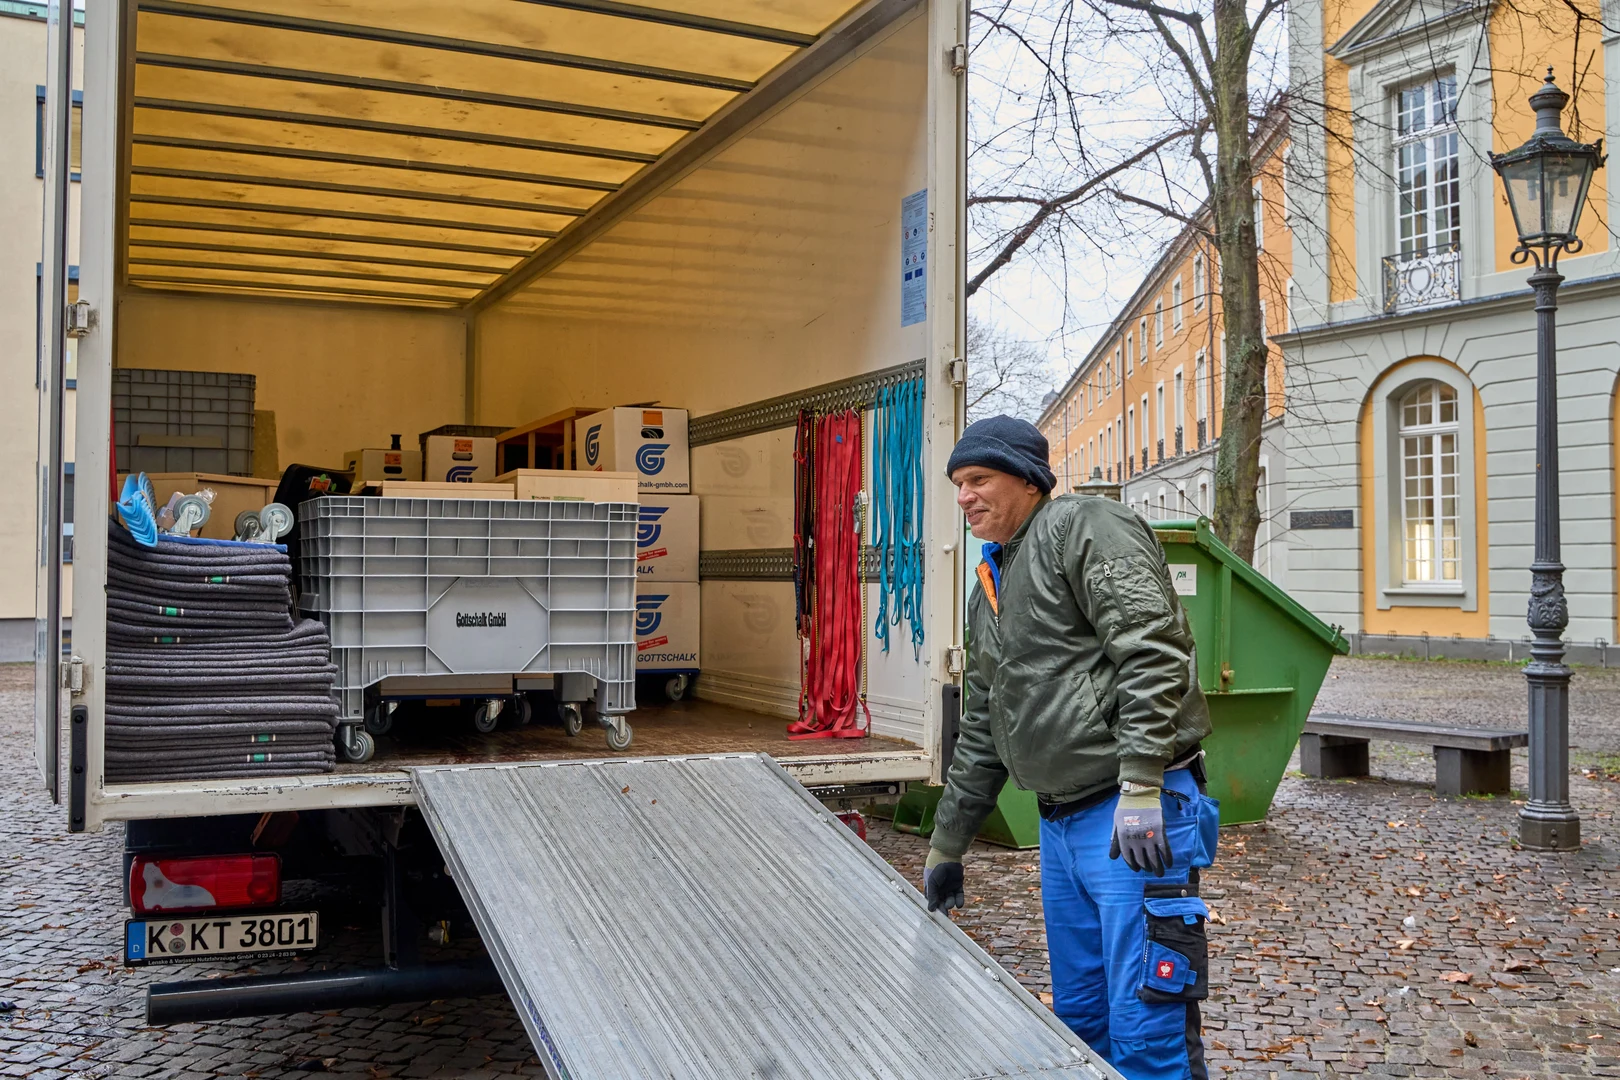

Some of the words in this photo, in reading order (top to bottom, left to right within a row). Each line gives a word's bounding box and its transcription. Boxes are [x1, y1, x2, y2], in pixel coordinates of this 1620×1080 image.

[456, 612, 487, 628] Gottschalk
[488, 612, 506, 627] GmbH
[637, 653, 697, 662] GOTTSCHALK
[132, 944, 140, 953] D
[148, 924, 168, 954] K
[190, 921, 231, 951] KT
[239, 917, 314, 948] 3801
